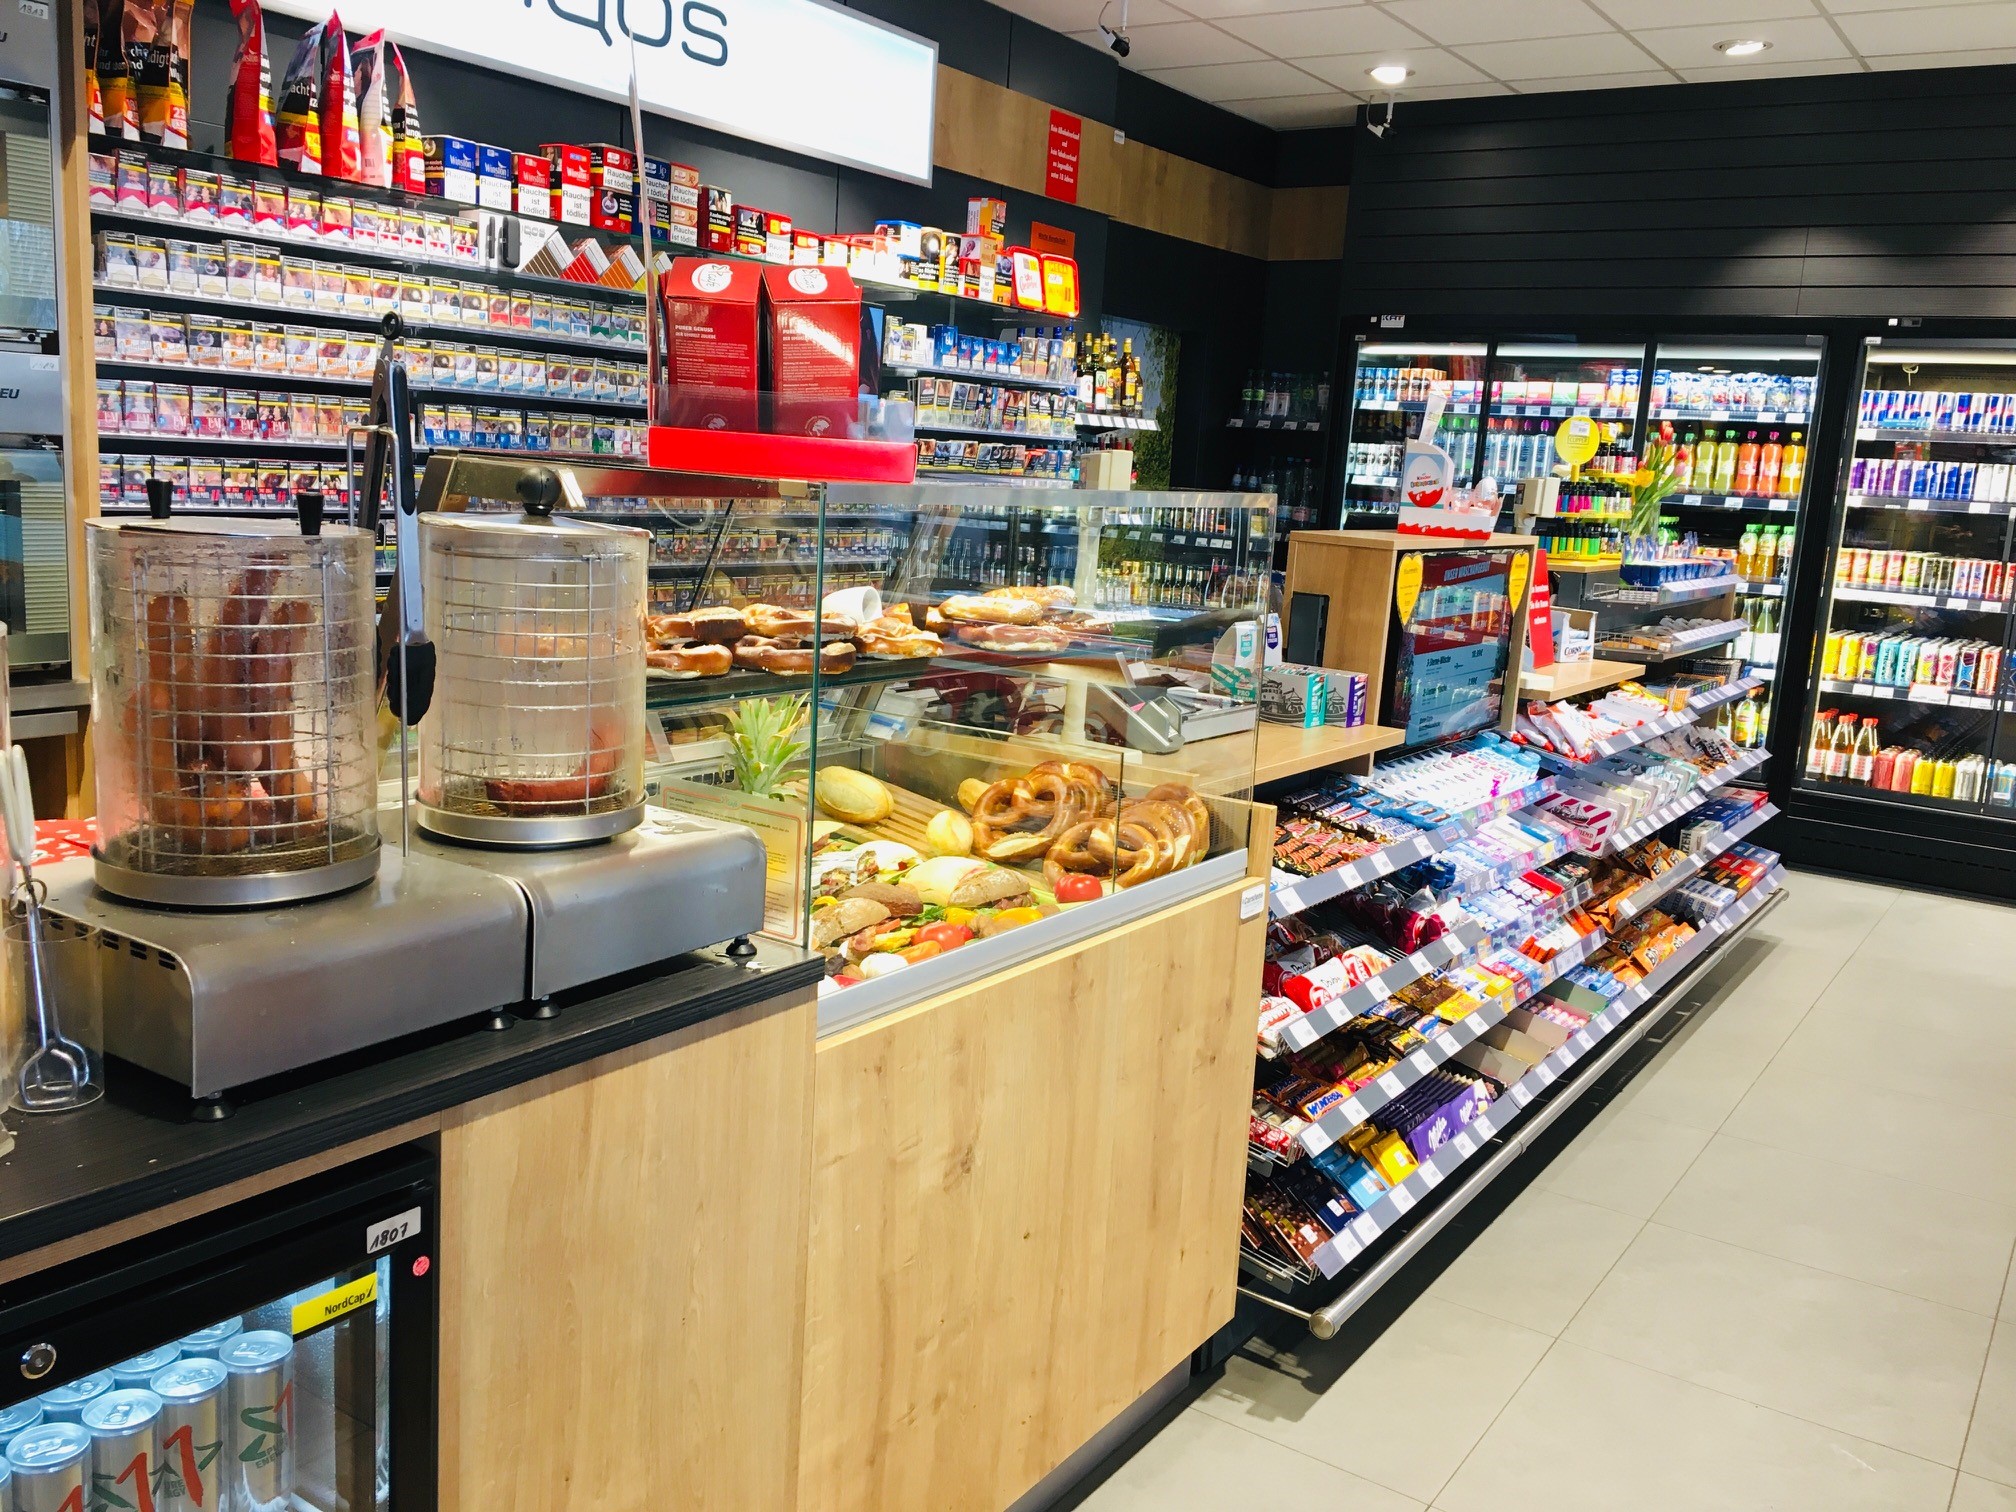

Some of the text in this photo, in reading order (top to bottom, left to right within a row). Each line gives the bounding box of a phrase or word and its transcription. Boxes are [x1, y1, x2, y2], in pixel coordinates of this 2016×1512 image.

[523, 0, 728, 67] QOS
[450, 155, 472, 168] Winston
[485, 162, 508, 176] Winston
[563, 190, 590, 201] Rauchen
[574, 201, 582, 210] ist
[566, 209, 588, 220] tödlich
[1428, 1117, 1448, 1152] Milka
[369, 1222, 408, 1251] 1807
[324, 1291, 365, 1316] NordCap
